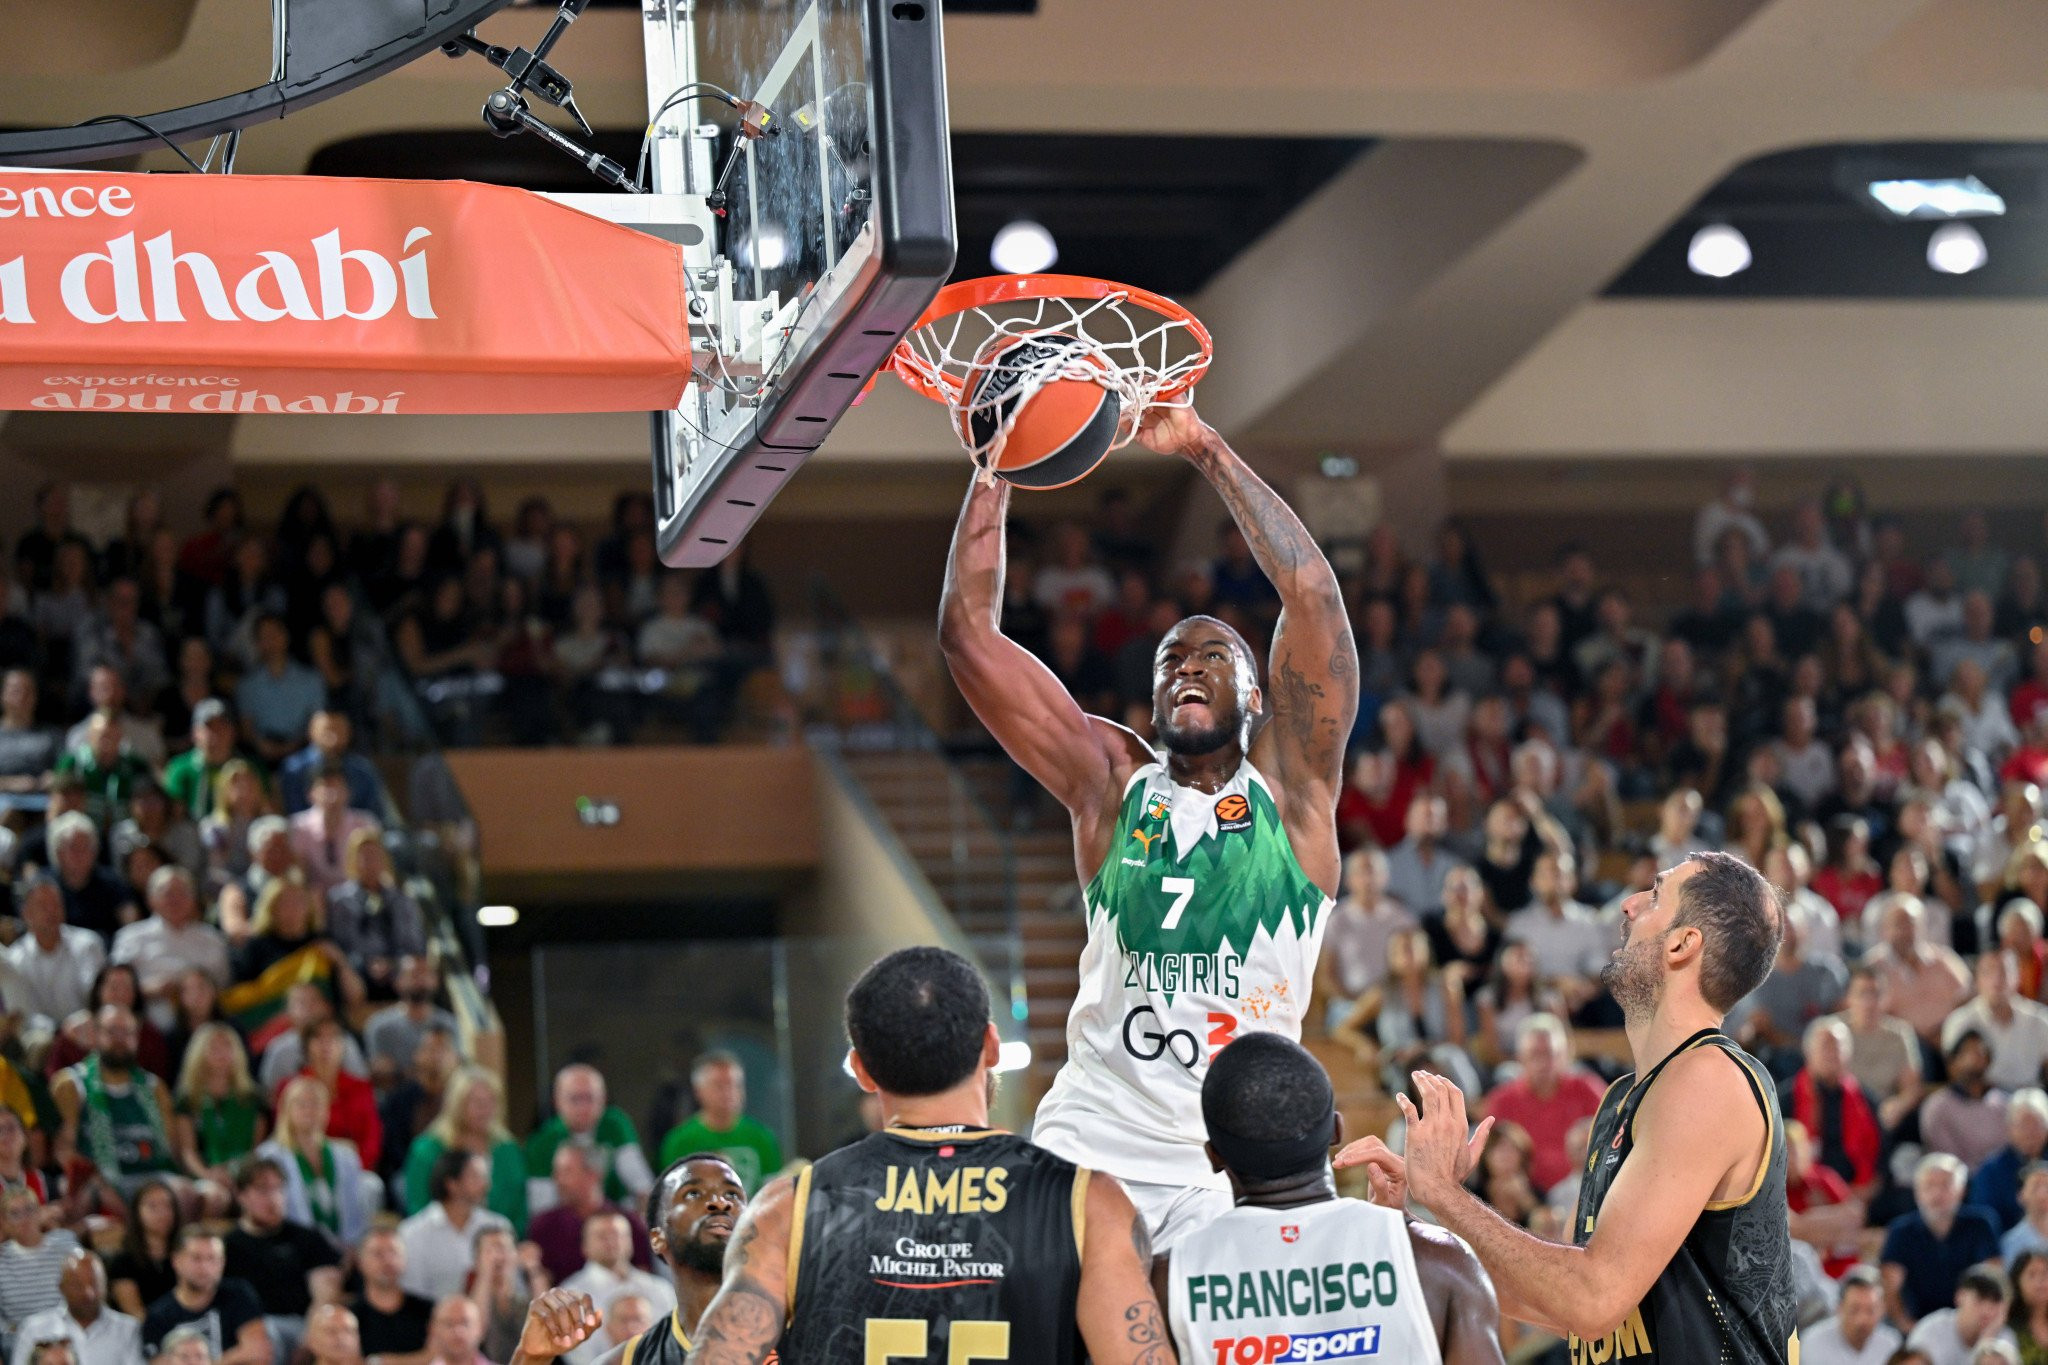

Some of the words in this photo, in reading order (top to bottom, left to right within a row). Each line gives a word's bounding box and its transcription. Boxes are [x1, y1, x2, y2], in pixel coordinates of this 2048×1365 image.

[30, 388, 172, 411] abu
[1161, 876, 1195, 929] 7
[1124, 951, 1242, 999] ZLGIRIS
[875, 1165, 1009, 1215] JAMES
[1187, 1261, 1397, 1322] FRANCISCO
